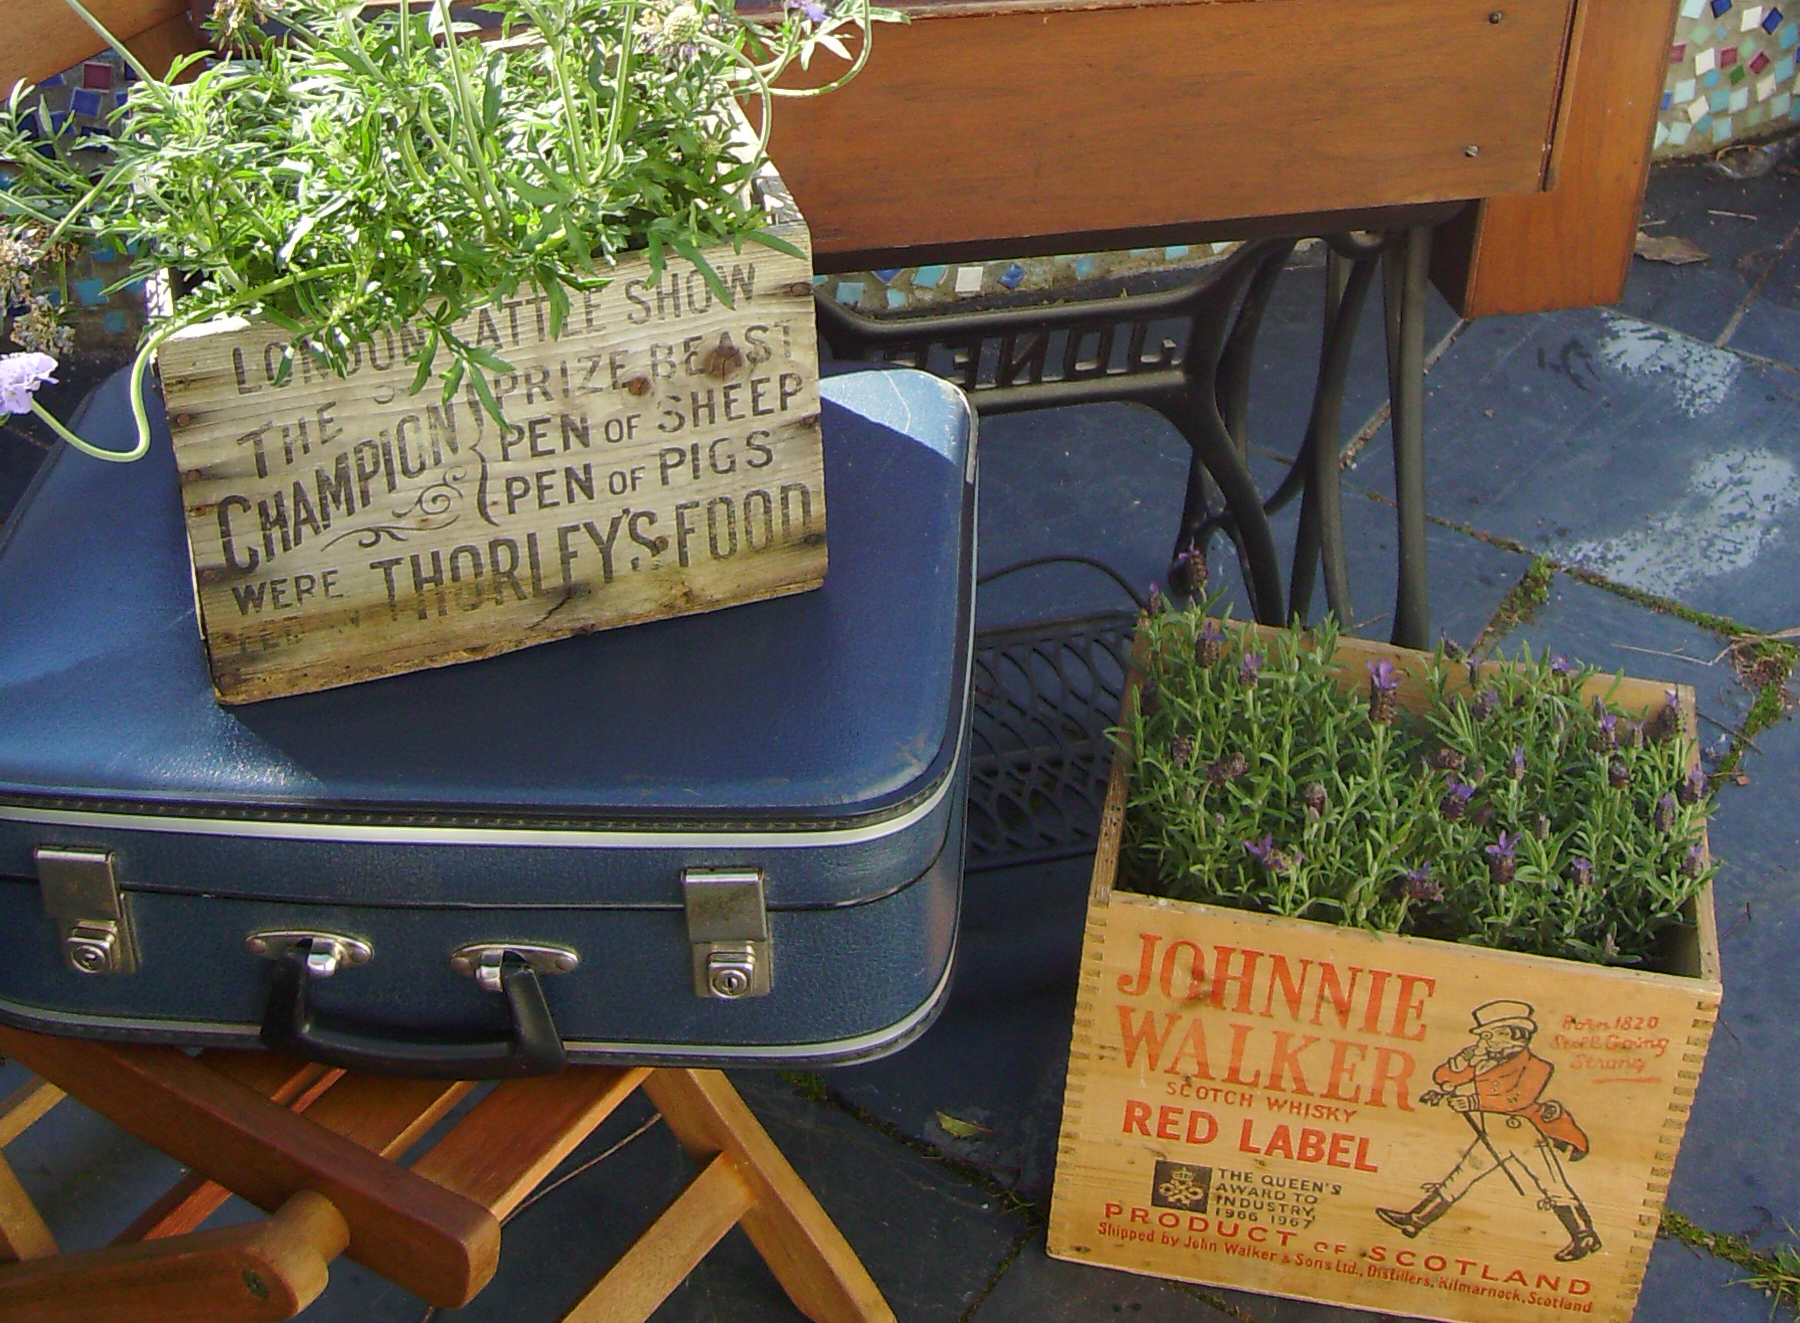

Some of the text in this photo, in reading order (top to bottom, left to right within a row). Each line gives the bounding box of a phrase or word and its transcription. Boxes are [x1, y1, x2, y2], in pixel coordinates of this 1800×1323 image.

[464, 287, 606, 350] ATTLE
[624, 262, 756, 325] SHOW
[494, 349, 630, 409] PRIZE
[500, 372, 804, 461] PEN OF SHEEP
[236, 401, 343, 478] THE
[505, 430, 774, 514] PEN OF PIGS
[217, 403, 459, 574] CHAMPION
[232, 568, 344, 616] WERE
[675, 482, 812, 567] FOOD
[1116, 932, 1436, 1042] JOHNNIE
[1615, 1016, 1659, 1030] 1820
[1116, 1004, 1416, 1112] WALKER
[1605, 1033, 1670, 1057] Going
[1122, 1098, 1378, 1172] RED LABEL
[1166, 1081, 1358, 1123] SCOTCH WHISKY
[1215, 1182, 1319, 1205] AWARD TO
[1215, 1207, 1313, 1229] 1966 1967
[1218, 1167, 1342, 1195] THE QUEEN'S
[1099, 1222, 1155, 1242] Shipped
[1161, 1231, 1179, 1247] by
[1184, 1236, 1217, 1252] John
[1225, 1242, 1277, 1261] Walker
[1295, 1253, 1332, 1271] Sons
[1104, 1202, 1592, 1296] PRODUCT OF SCOTLAND
